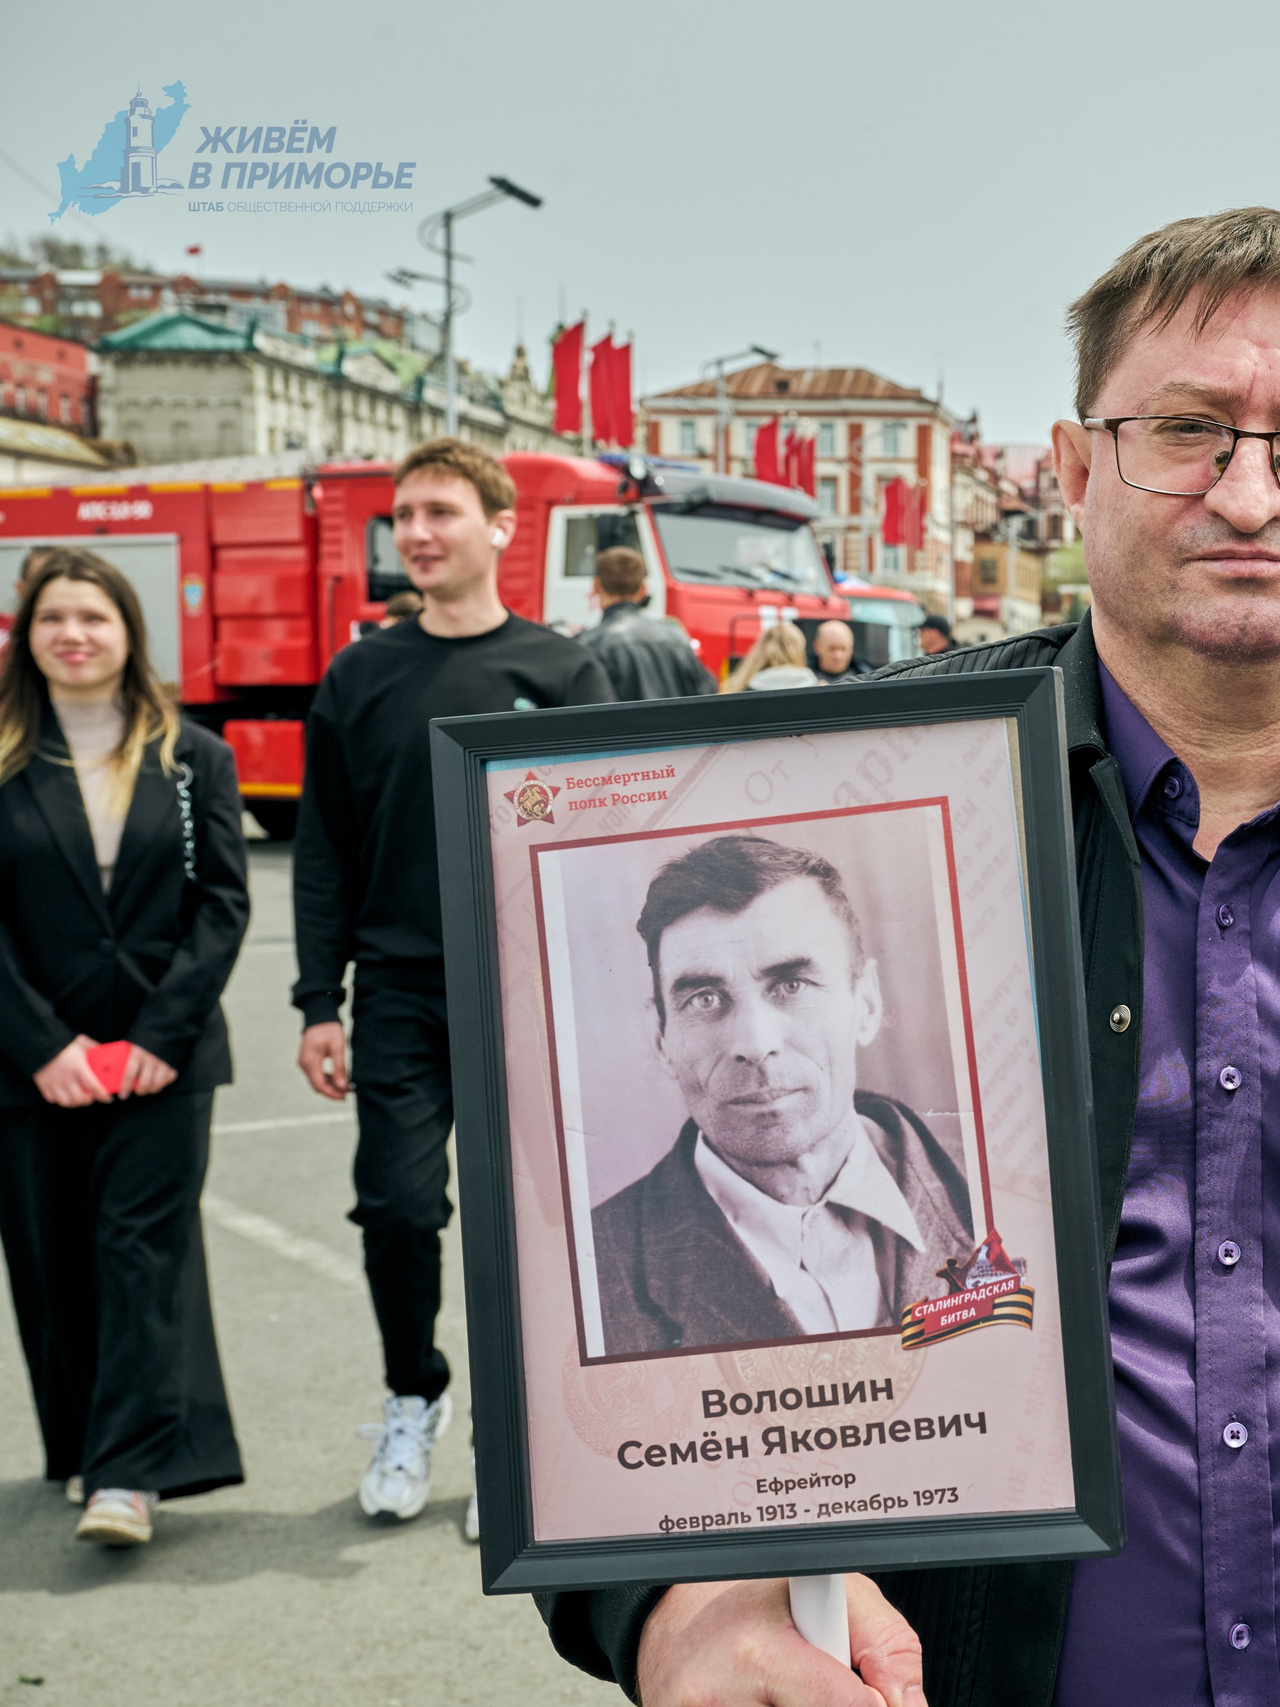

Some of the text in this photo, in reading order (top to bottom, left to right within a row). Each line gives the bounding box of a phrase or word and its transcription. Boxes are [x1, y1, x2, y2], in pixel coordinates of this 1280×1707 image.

[565, 764, 676, 790] Бессмертный
[568, 795, 608, 812] полк
[610, 789, 669, 807] России
[914, 1279, 1015, 1318] СТАЛИНГРАДСКАЯ
[940, 1307, 977, 1327] БИТВА
[701, 1377, 894, 1419] Волошин
[617, 1411, 988, 1470] Семён Яковлевич
[755, 1470, 857, 1495] Ефрейтор
[658, 1511, 752, 1534] февраль
[756, 1502, 798, 1522] 1913
[815, 1493, 909, 1519] декабрь
[913, 1486, 960, 1507] 1973
